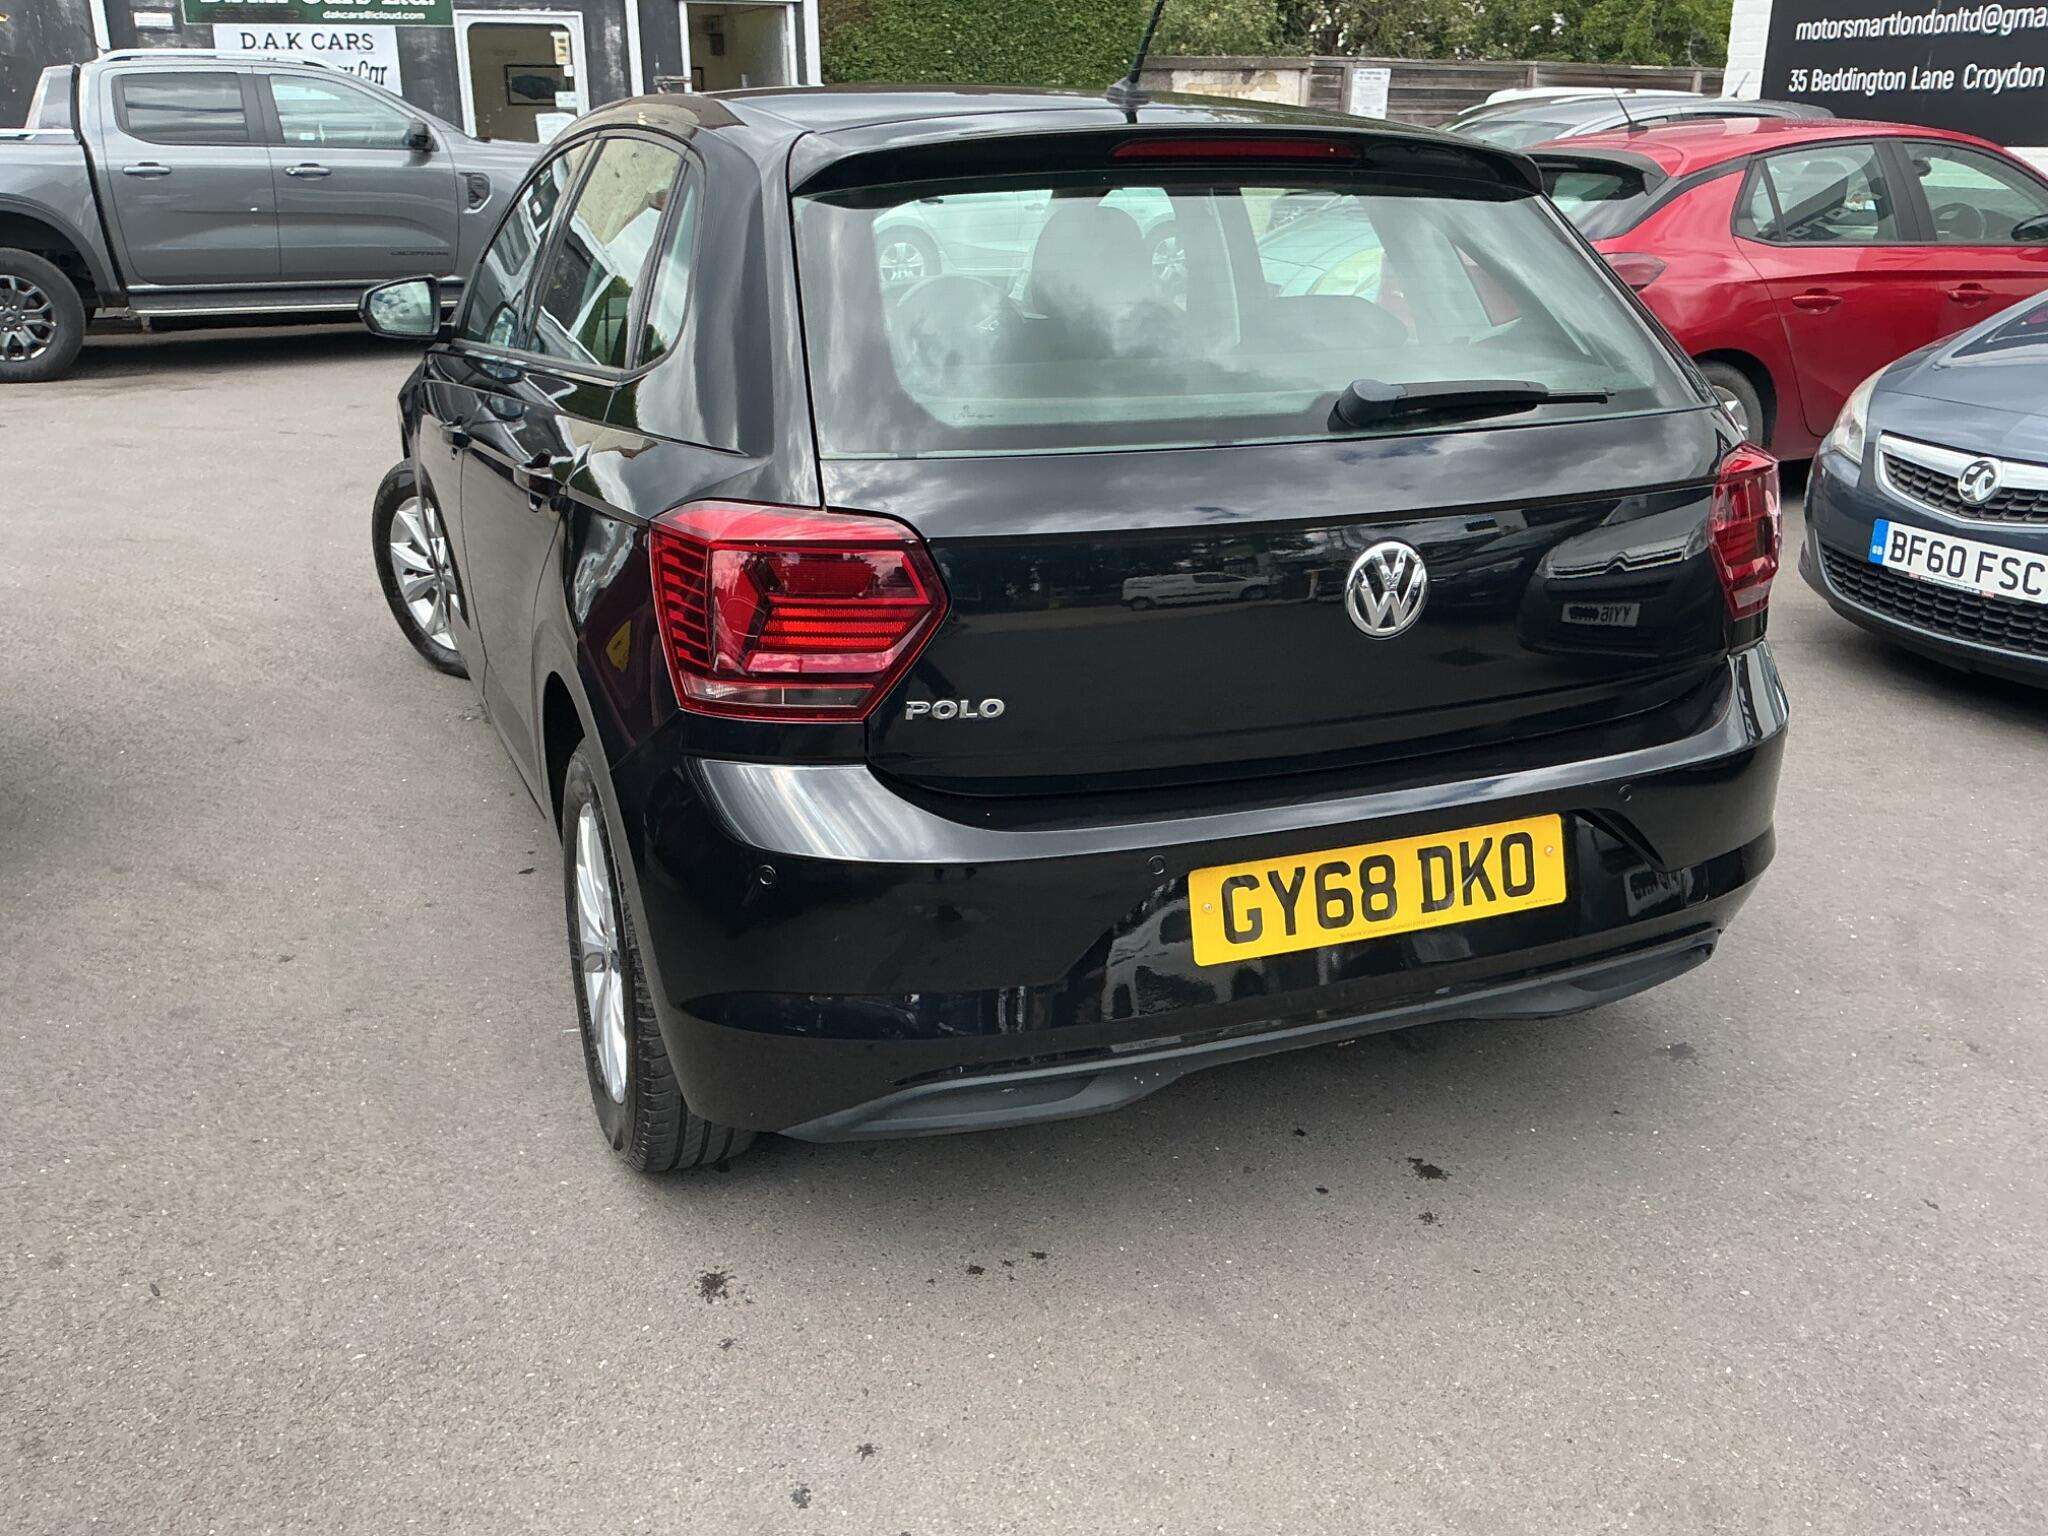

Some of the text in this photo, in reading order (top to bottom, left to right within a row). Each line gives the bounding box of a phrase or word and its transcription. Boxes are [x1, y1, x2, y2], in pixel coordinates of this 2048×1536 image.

[1795, 3, 2048, 40] motorsmartlondonltd@gma
[240, 32, 374, 50] D.A.K CARS
[1788, 61, 2045, 97] 35 Beddington Lane Croydon
[1889, 530, 1967, 578] BF60
[1974, 551, 2046, 596] FSC
[905, 698, 1005, 720] POLO
[1220, 831, 1535, 944] GY68 DKO
